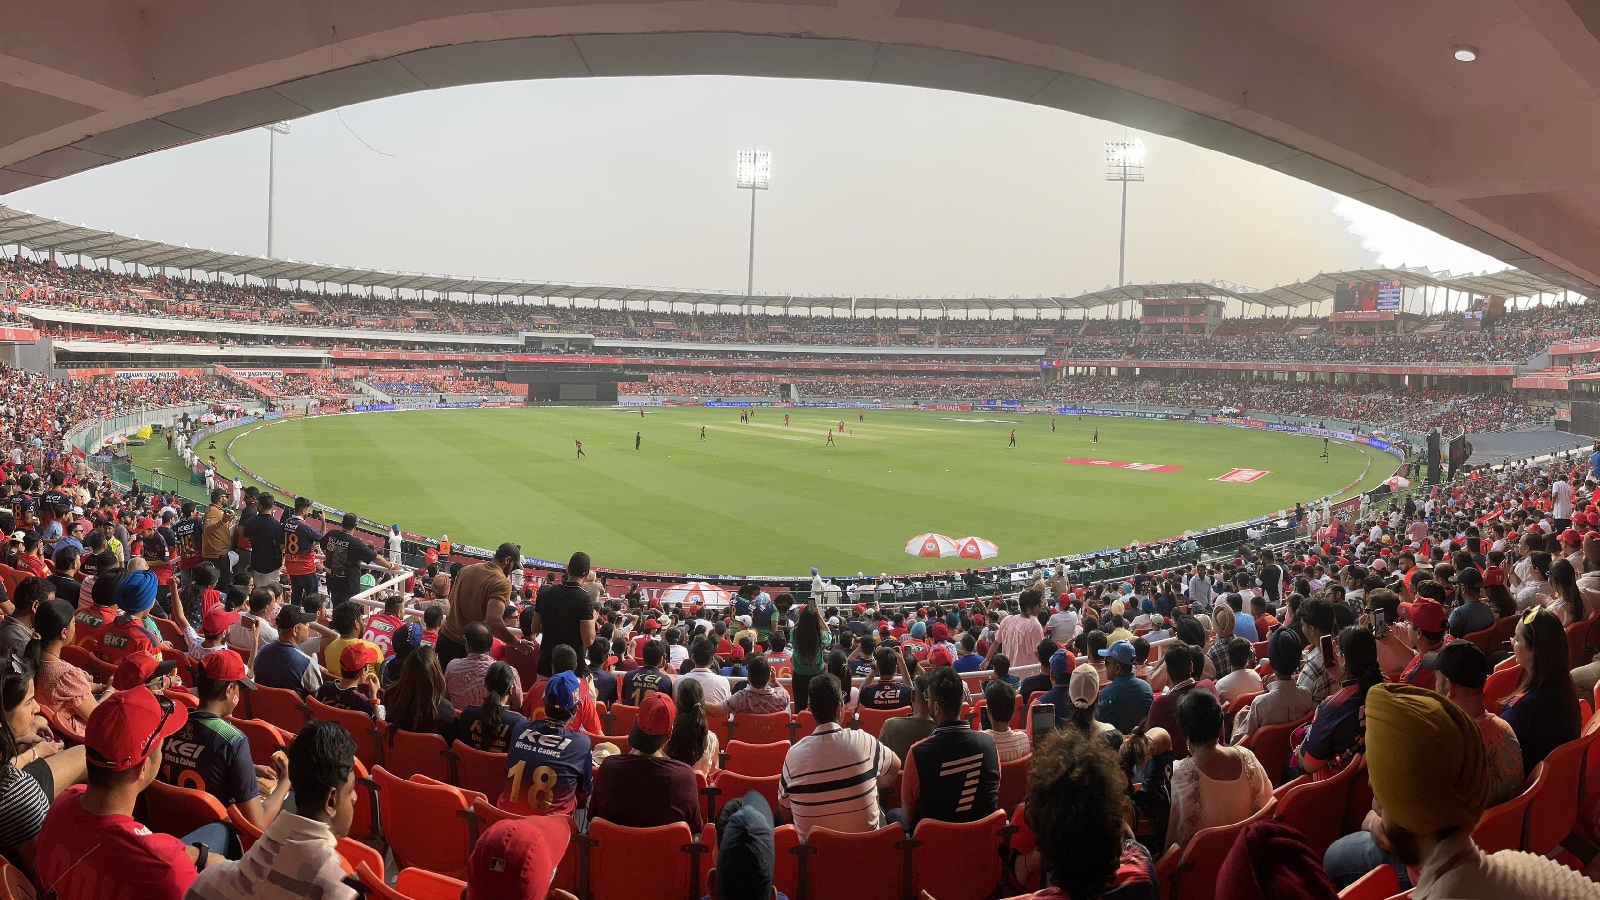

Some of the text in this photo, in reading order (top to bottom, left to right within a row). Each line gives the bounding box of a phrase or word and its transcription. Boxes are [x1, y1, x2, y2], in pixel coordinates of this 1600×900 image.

[75, 612, 103, 626] BKT
[104, 634, 127, 647] BKT
[856, 665, 872, 673] KE
[632, 673, 662, 683] KEI
[874, 690, 900, 699] KEI
[470, 719, 510, 738] KI
[519, 728, 572, 751] KEI
[165, 738, 206, 759] KEI
[514, 740, 532, 752] Wires
[537, 746, 561, 759] Cables
[507, 759, 558, 811] 18
